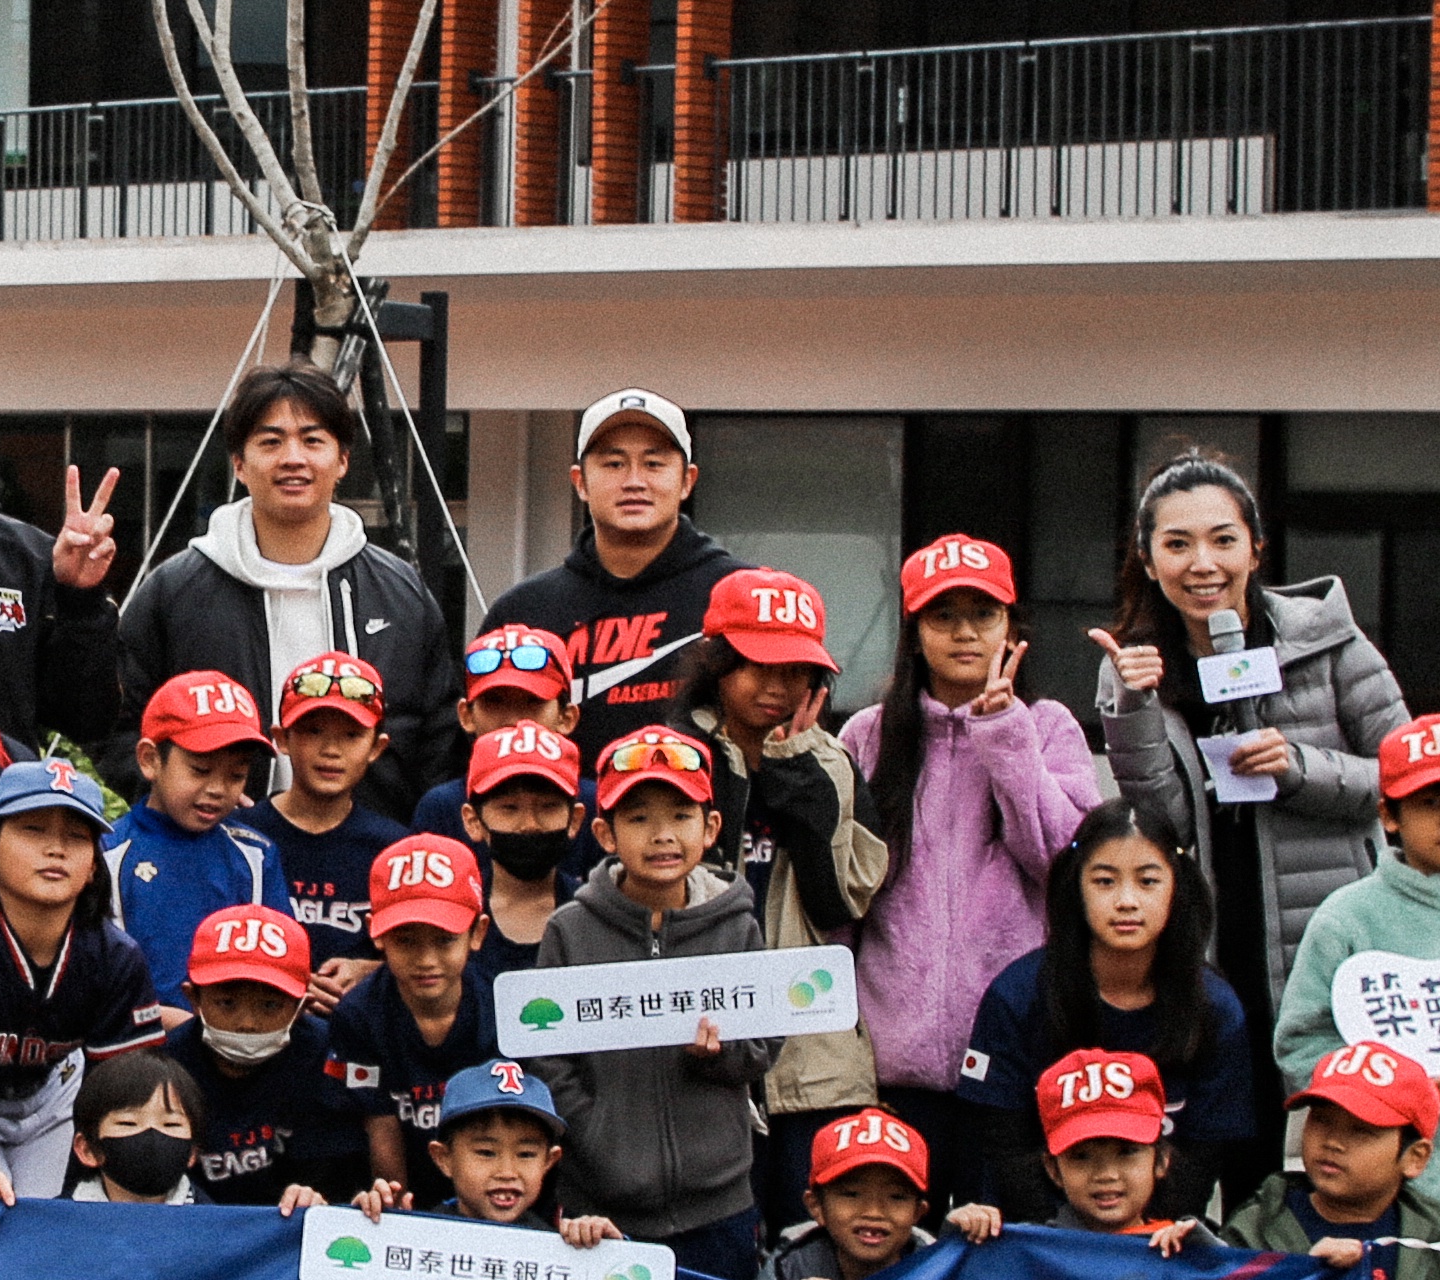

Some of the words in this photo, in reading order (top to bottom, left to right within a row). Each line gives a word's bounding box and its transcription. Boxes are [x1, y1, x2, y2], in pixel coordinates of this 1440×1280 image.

[919, 541, 991, 580] TJS
[751, 586, 820, 629] TJS
[189, 684, 255, 720] TJS
[494, 724, 562, 761] TJS
[44, 758, 79, 792] T
[387, 850, 455, 891] TJS
[214, 918, 288, 959] TJS
[575, 983, 758, 1024] 國泰世華銀行
[490, 1060, 525, 1095] T
[1056, 1062, 1135, 1110] TJS
[1322, 1046, 1398, 1088] TJS
[832, 1116, 912, 1154] TJS
